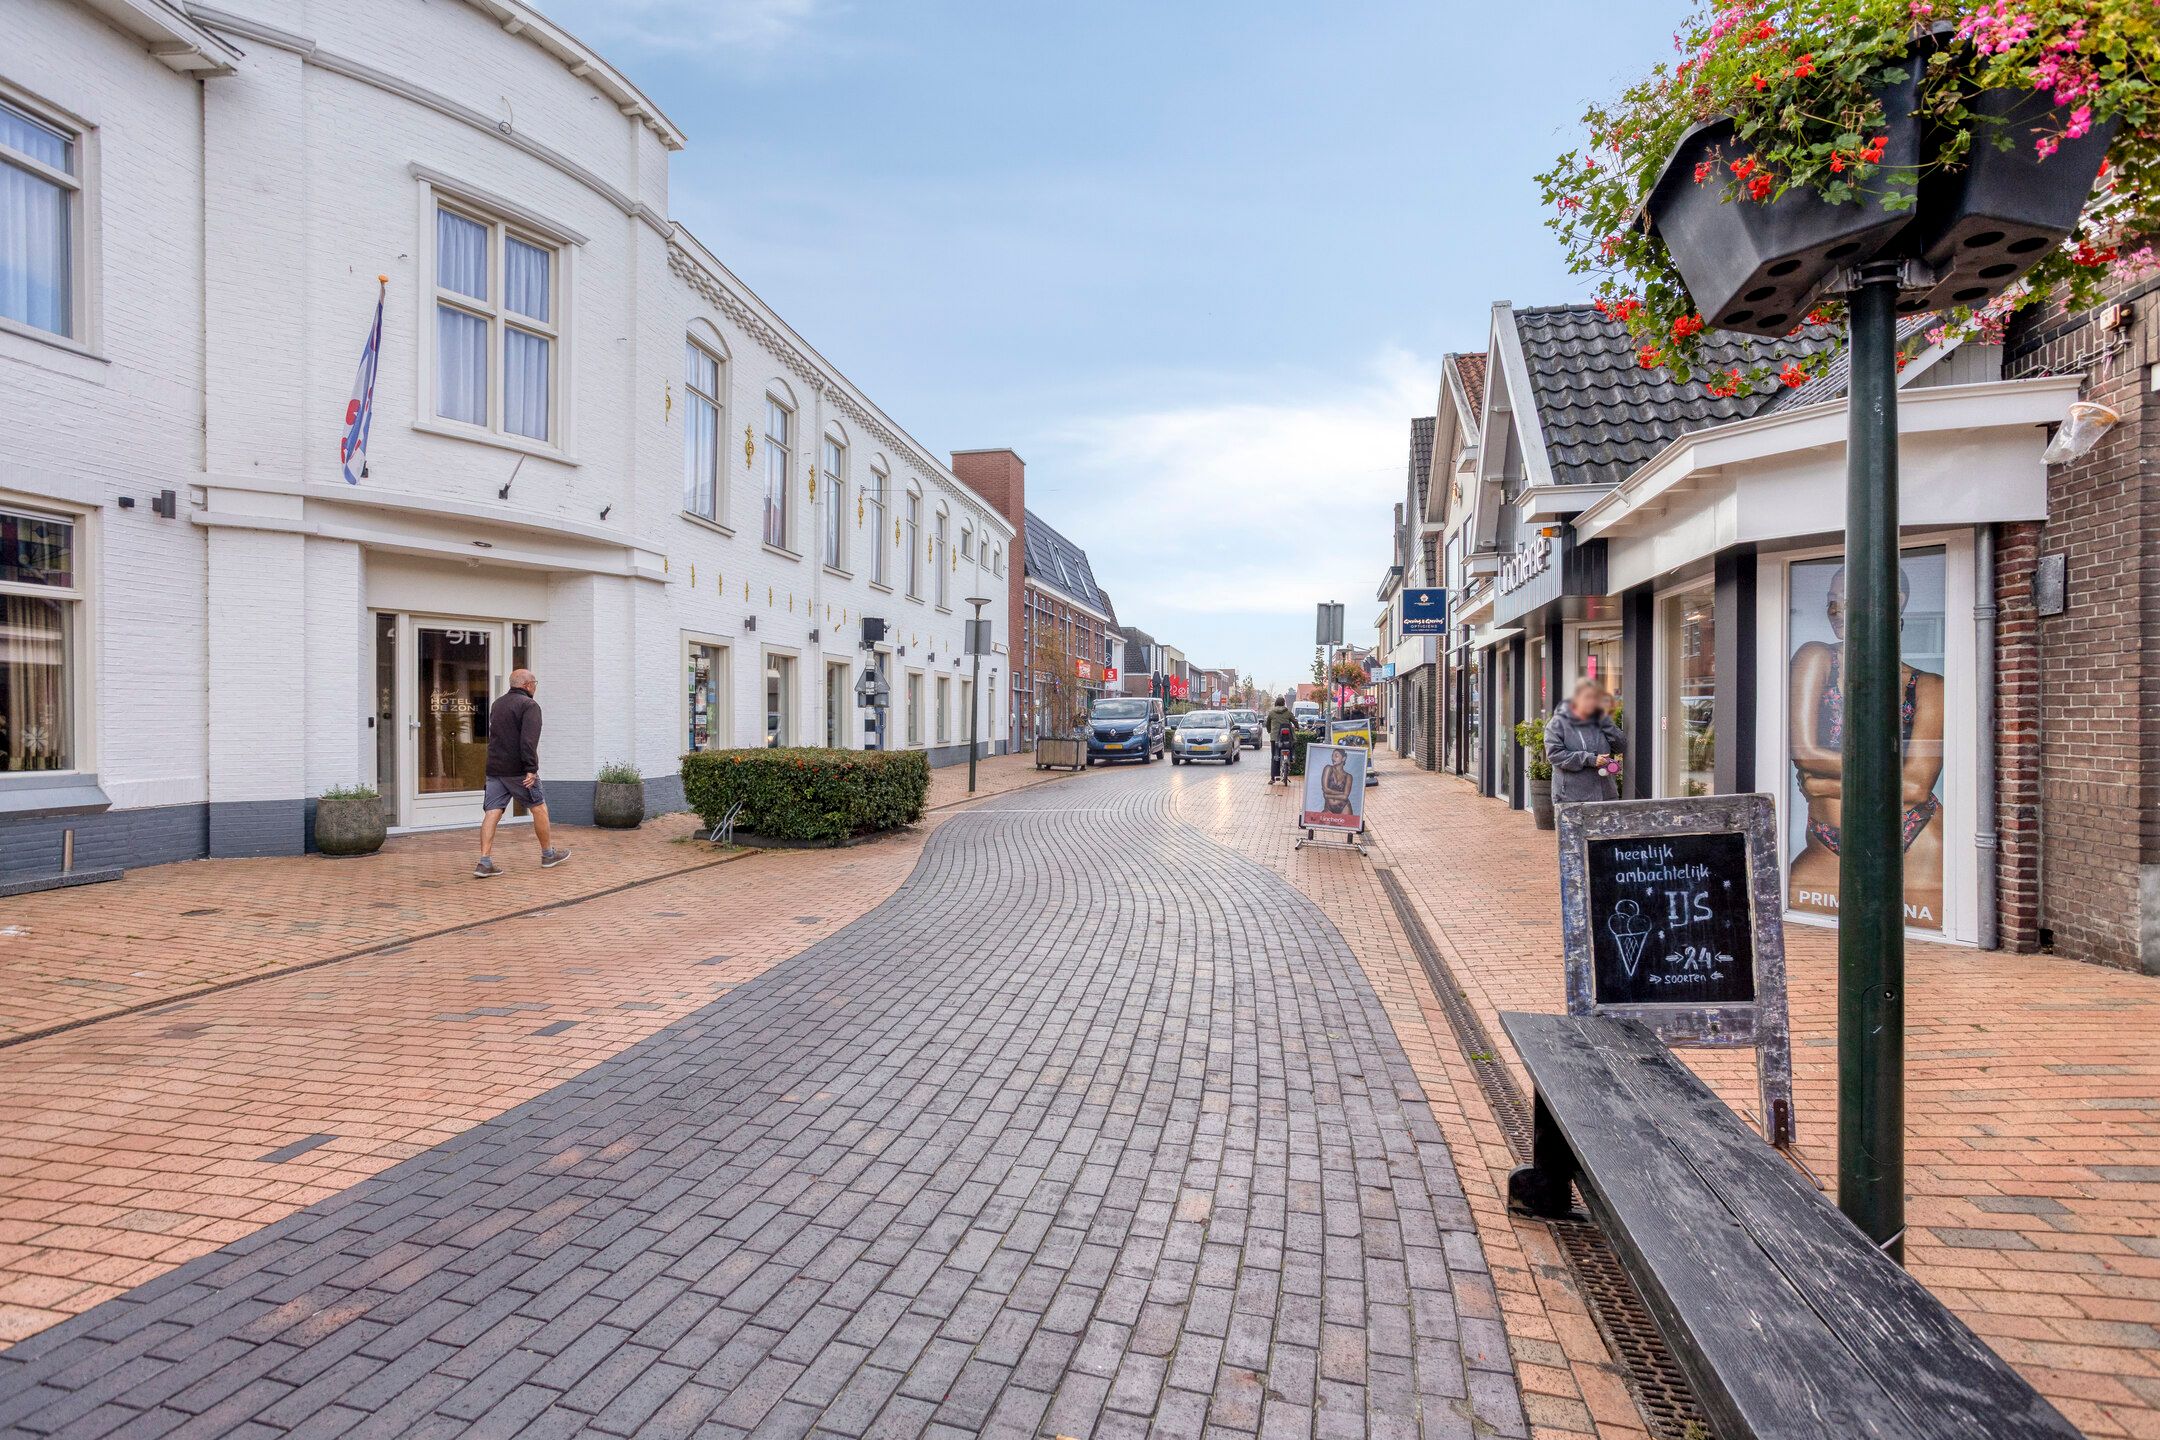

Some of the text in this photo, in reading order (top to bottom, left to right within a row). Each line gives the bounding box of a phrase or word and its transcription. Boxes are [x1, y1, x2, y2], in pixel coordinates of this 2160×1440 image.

[430, 704, 476, 712] DE ZON
[1615, 863, 1709, 884] ambachtelijk
[1664, 890, 1713, 928] IJS
[1683, 946, 1711, 970] 24
